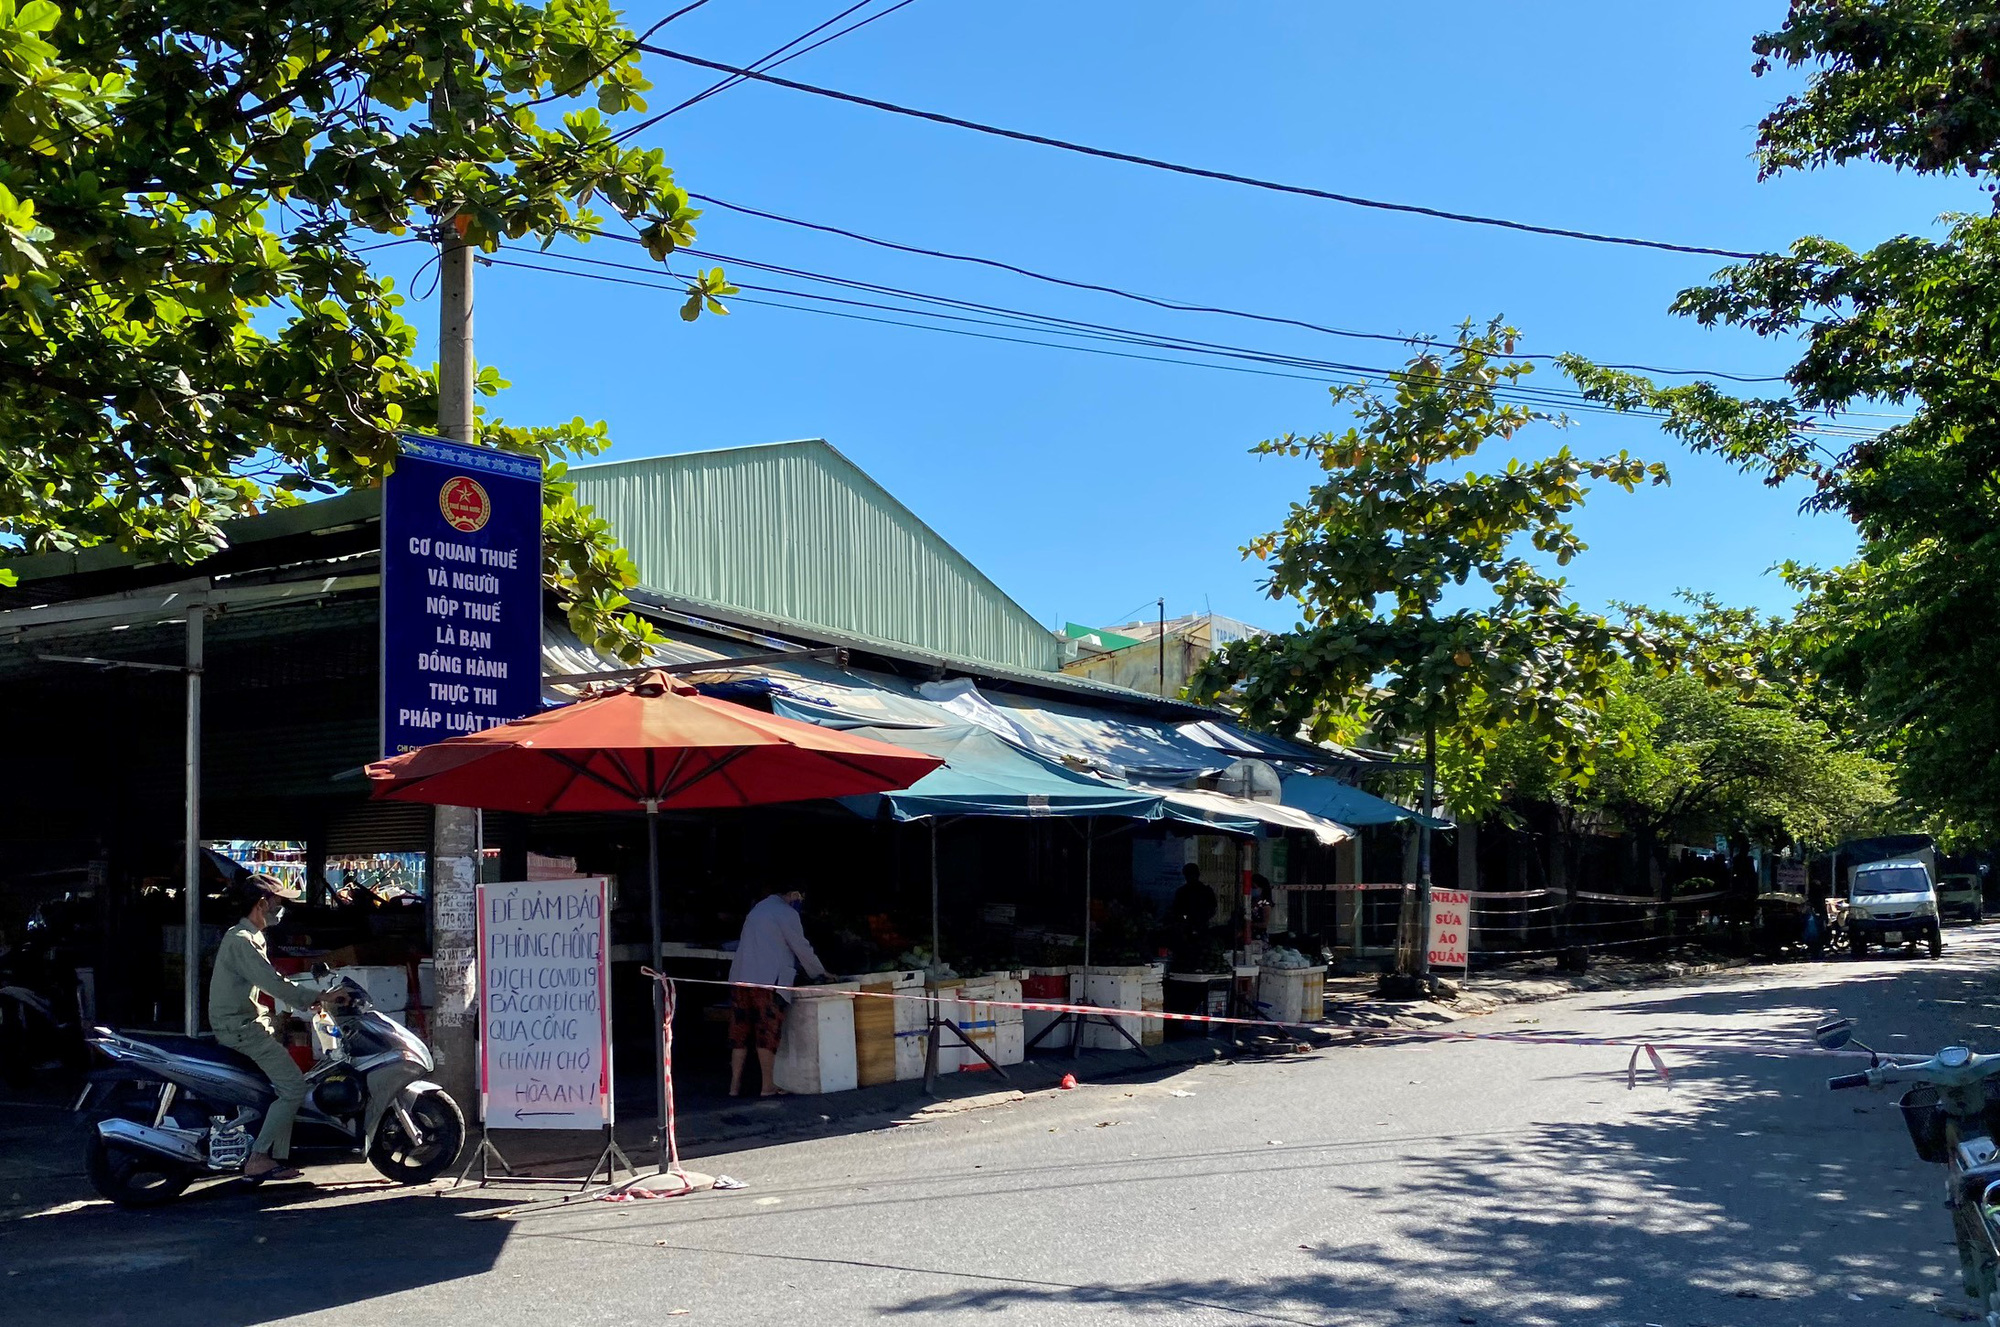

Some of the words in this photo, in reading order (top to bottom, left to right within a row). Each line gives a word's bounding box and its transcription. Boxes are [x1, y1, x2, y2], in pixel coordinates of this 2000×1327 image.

[409, 537, 431, 556] CƠ
[435, 541, 476, 563] QUAN
[480, 548, 518, 570] THUẾ
[428, 566, 448, 587] VÀ
[453, 573, 499, 595] NGƯỜI
[426, 595, 459, 619] NỘP
[463, 601, 501, 623] THUẾ
[436, 624, 455, 645] LÀ
[460, 629, 491, 651] BẠN
[418, 649, 461, 674] ĐỒNG
[466, 656, 508, 679] HÀNH
[429, 682, 469, 705] THỰC
[473, 687, 497, 705] THI
[399, 707, 442, 729] PHÁP
[446, 711, 484, 735] LUẬT
[491, 887, 519, 924] ĐỂ
[1435, 910, 1462, 925] SỬA
[490, 927, 549, 959] PHÒNG
[551, 923, 601, 960] CHỐNG
[1438, 930, 1458, 944] ÁO
[490, 966, 533, 992] DỊCH
[490, 989, 518, 1014] BÀ
[519, 994, 552, 1013] CON
[489, 1019, 529, 1042] QUA
[530, 1013, 578, 1041] CỔNG
[499, 1042, 552, 1071] CHÍNH
[556, 1047, 590, 1073] CHỢ
[515, 1077, 552, 1103] HÒA
